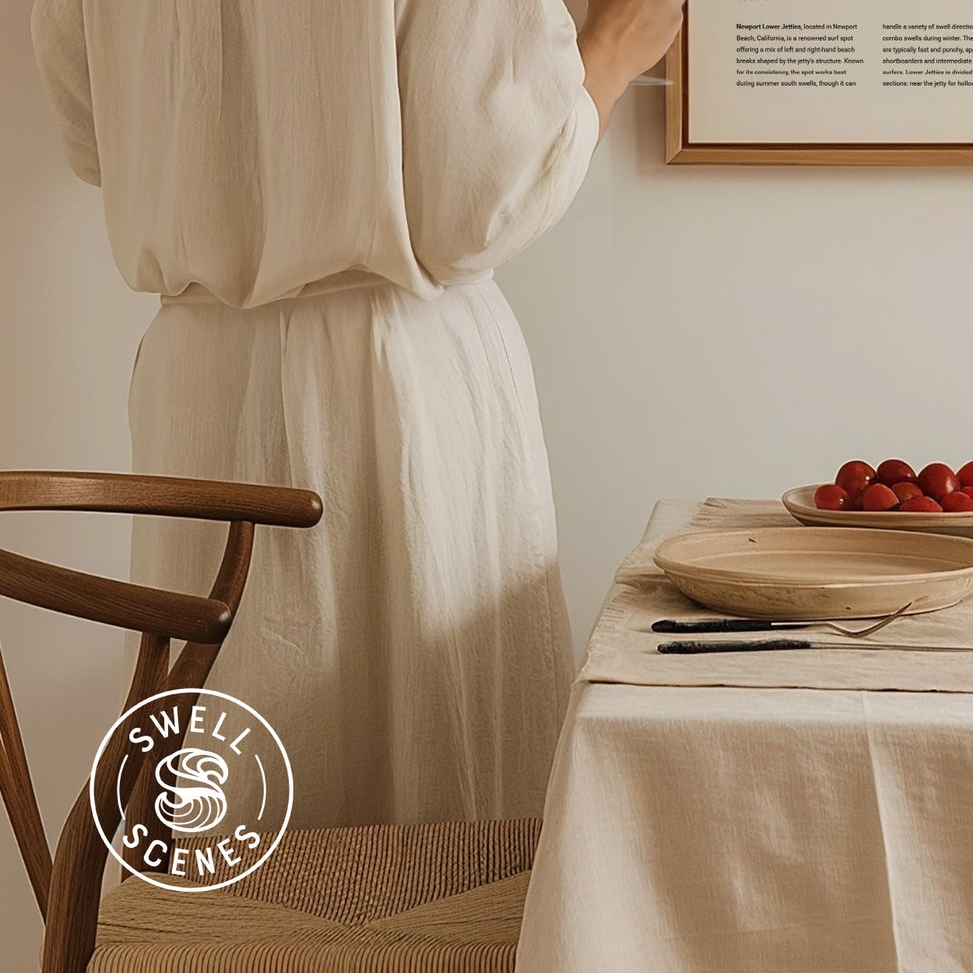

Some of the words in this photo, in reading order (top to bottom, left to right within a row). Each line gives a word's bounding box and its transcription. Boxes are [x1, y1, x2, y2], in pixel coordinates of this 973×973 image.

[736, 35, 755, 43] Beach,
[757, 35, 785, 43] California,
[840, 35, 853, 43] spot
